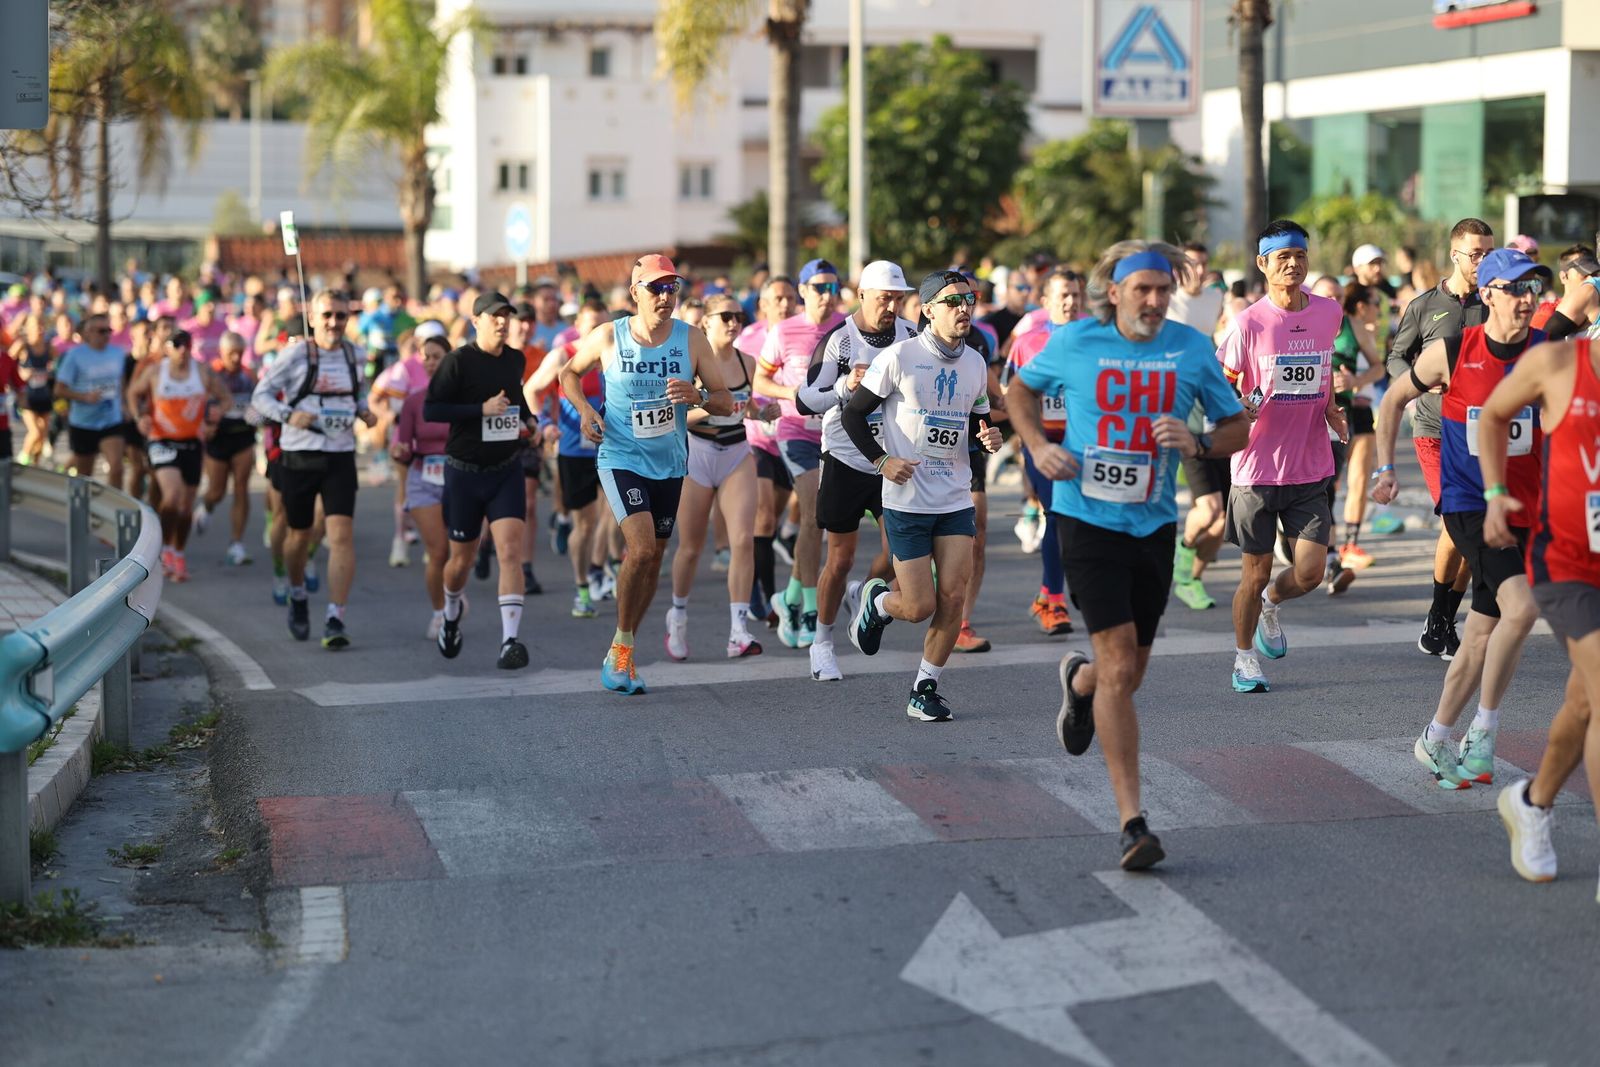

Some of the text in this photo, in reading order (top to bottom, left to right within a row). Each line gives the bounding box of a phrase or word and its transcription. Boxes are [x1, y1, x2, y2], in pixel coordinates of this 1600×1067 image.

[1288, 340, 1314, 351] XXXVI
[620, 356, 681, 378] nerja
[1098, 358, 1177, 369] BANK OF AMERICA
[1282, 366, 1315, 381] 380
[1096, 369, 1177, 413] CHI
[486, 416, 518, 430] 1065
[635, 406, 674, 426] 1128
[927, 428, 959, 447] 363
[1093, 462, 1138, 486] 595
